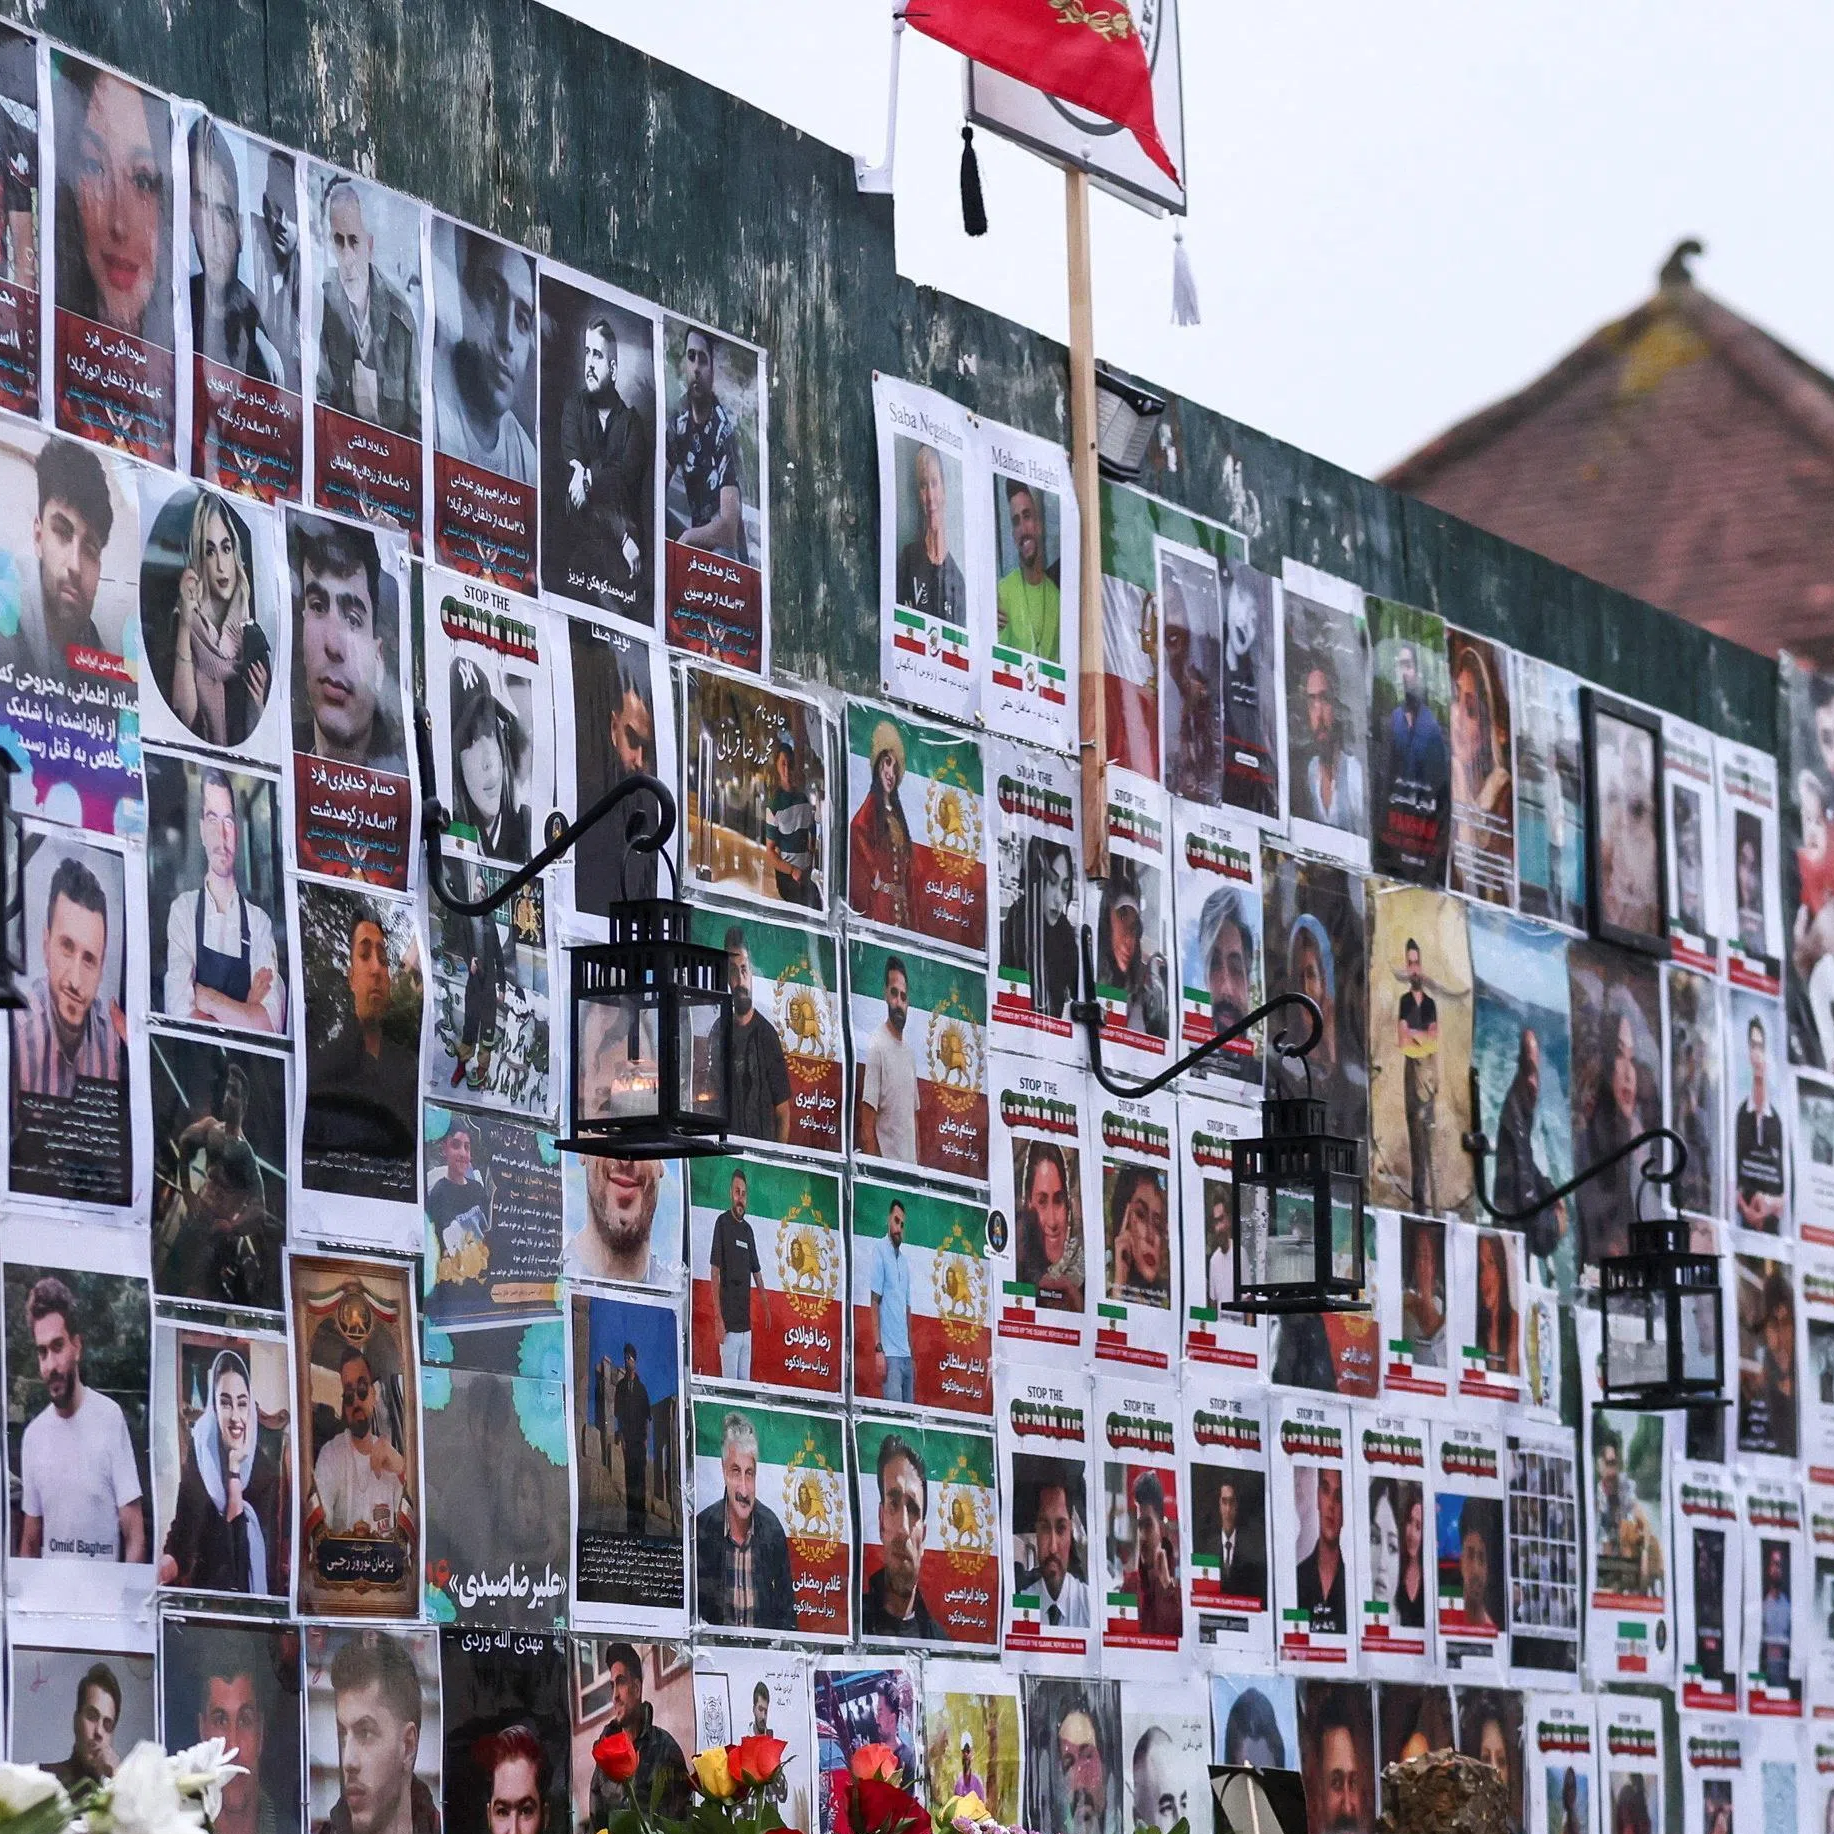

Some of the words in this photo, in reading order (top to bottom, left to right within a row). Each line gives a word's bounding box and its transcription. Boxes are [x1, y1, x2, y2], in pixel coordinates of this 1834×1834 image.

[889, 401, 919, 430] Saba
[991, 444, 1027, 472] Mahan
[724, 568, 741, 585] مختار
[464, 585, 489, 604] STOP
[491, 593, 510, 612] THE
[683, 587, 712, 605] هرسین
[441, 596, 539, 665] GENOCIDE
[5, 695, 42, 722] شلیک
[44, 702, 53, 729] با
[105, 719, 116, 742] از
[49, 736, 70, 760] قتل
[73, 749, 87, 768] به
[311, 764, 328, 785] فرد
[329, 770, 367, 792] خدایاری
[1038, 770, 1053, 786] THE
[369, 777, 396, 799] حسام
[310, 800, 357, 827] کوهدشت
[357, 810, 364, 830] از
[1019, 1077, 1042, 1092] STOP
[1043, 1081, 1058, 1096] THE
[1117, 1100, 1136, 1114] STOP
[1137, 1102, 1151, 1118] THE
[784, 1325, 816, 1350] فولادی
[815, 1330, 832, 1353] رضا
[1027, 1385, 1047, 1400] STOP
[1048, 1388, 1063, 1401] THE
[1123, 1399, 1142, 1413] STOP
[1143, 1402, 1156, 1415] THE
[1209, 1398, 1227, 1411] STOP
[50, 1538, 75, 1553] Omid
[326, 1554, 351, 1572] رجبی
[371, 1559, 394, 1573] پژمان
[792, 1571, 824, 1593] رمضانی
[823, 1577, 841, 1598] غلام
[461, 1633, 491, 1653] وردی
[494, 1630, 511, 1648] الله
[514, 1635, 544, 1656] مهدی
